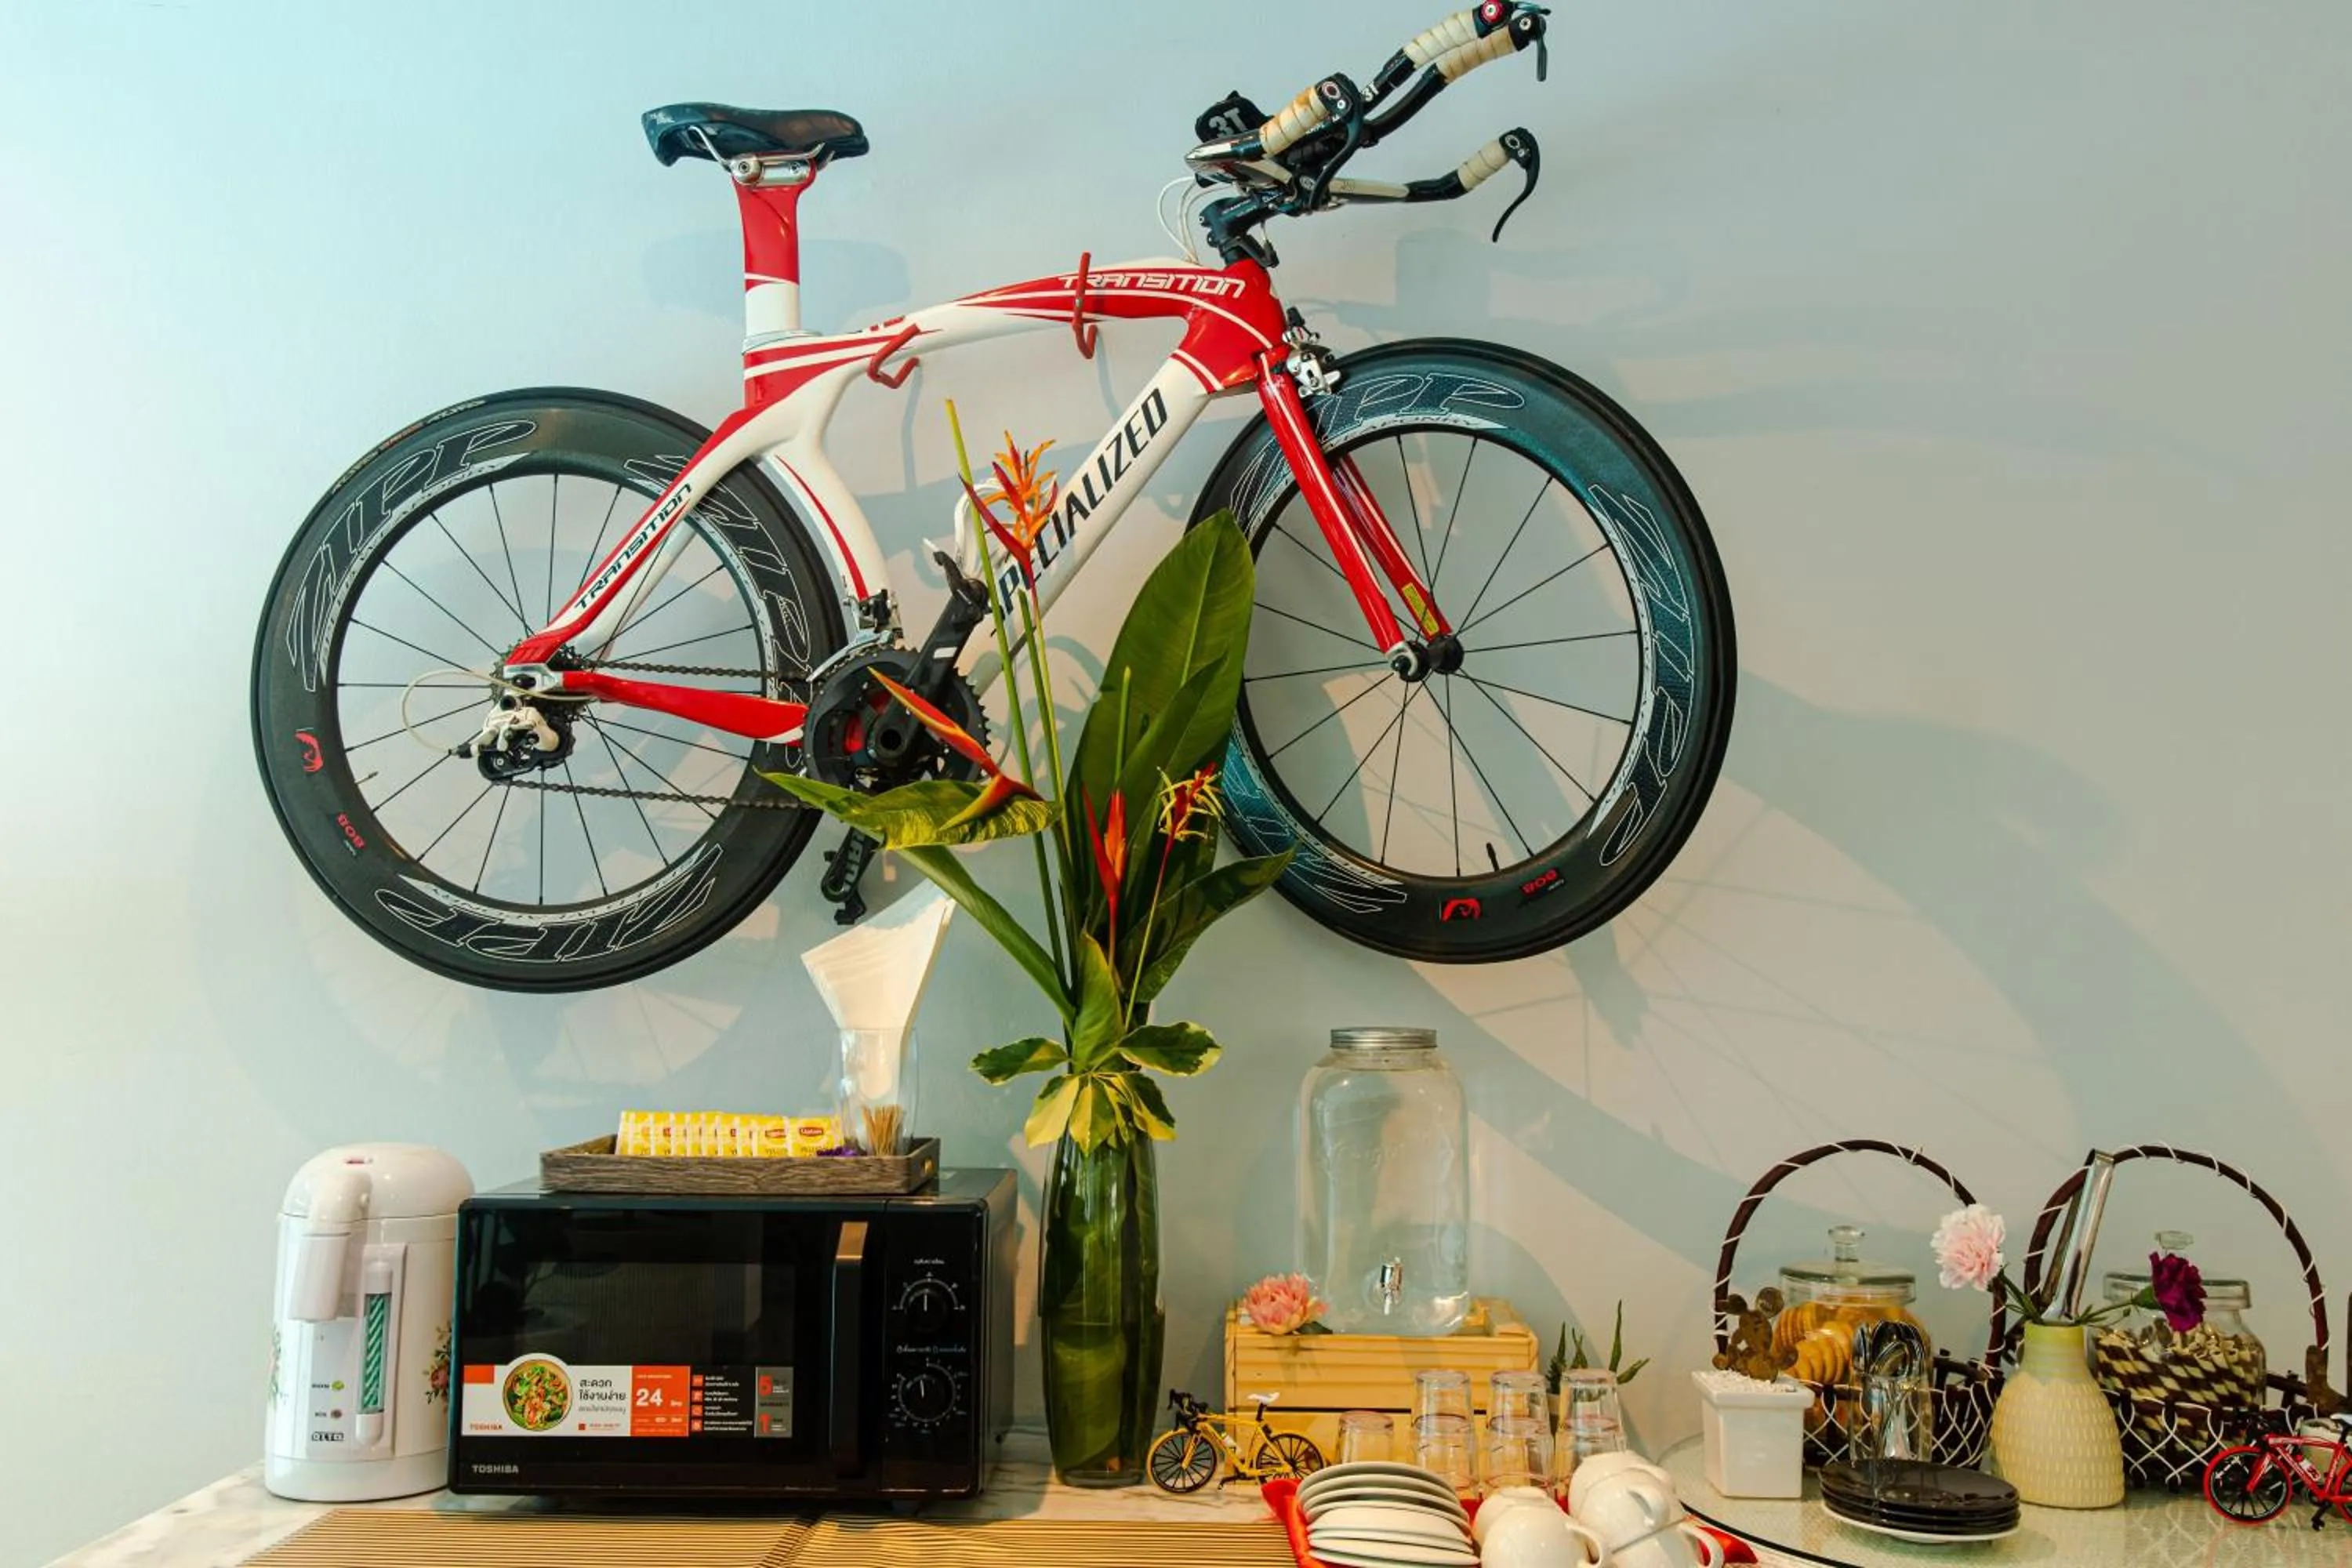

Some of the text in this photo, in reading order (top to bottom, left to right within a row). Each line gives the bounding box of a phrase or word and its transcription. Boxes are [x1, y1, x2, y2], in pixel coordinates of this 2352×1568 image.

[1208, 107, 1247, 140] 3T
[1058, 272, 1247, 299] TRANSITION
[286, 419, 537, 692] ZIPP
[574, 483, 691, 609] TRANSITION
[1588, 484, 1695, 866] ZIPP
[375, 843, 724, 964] ZIPP
[636, 1388, 662, 1406] 24
[759, 1375, 772, 1396] 5
[760, 1414, 771, 1433] 1
[472, 1465, 519, 1473] TOSHIBA
